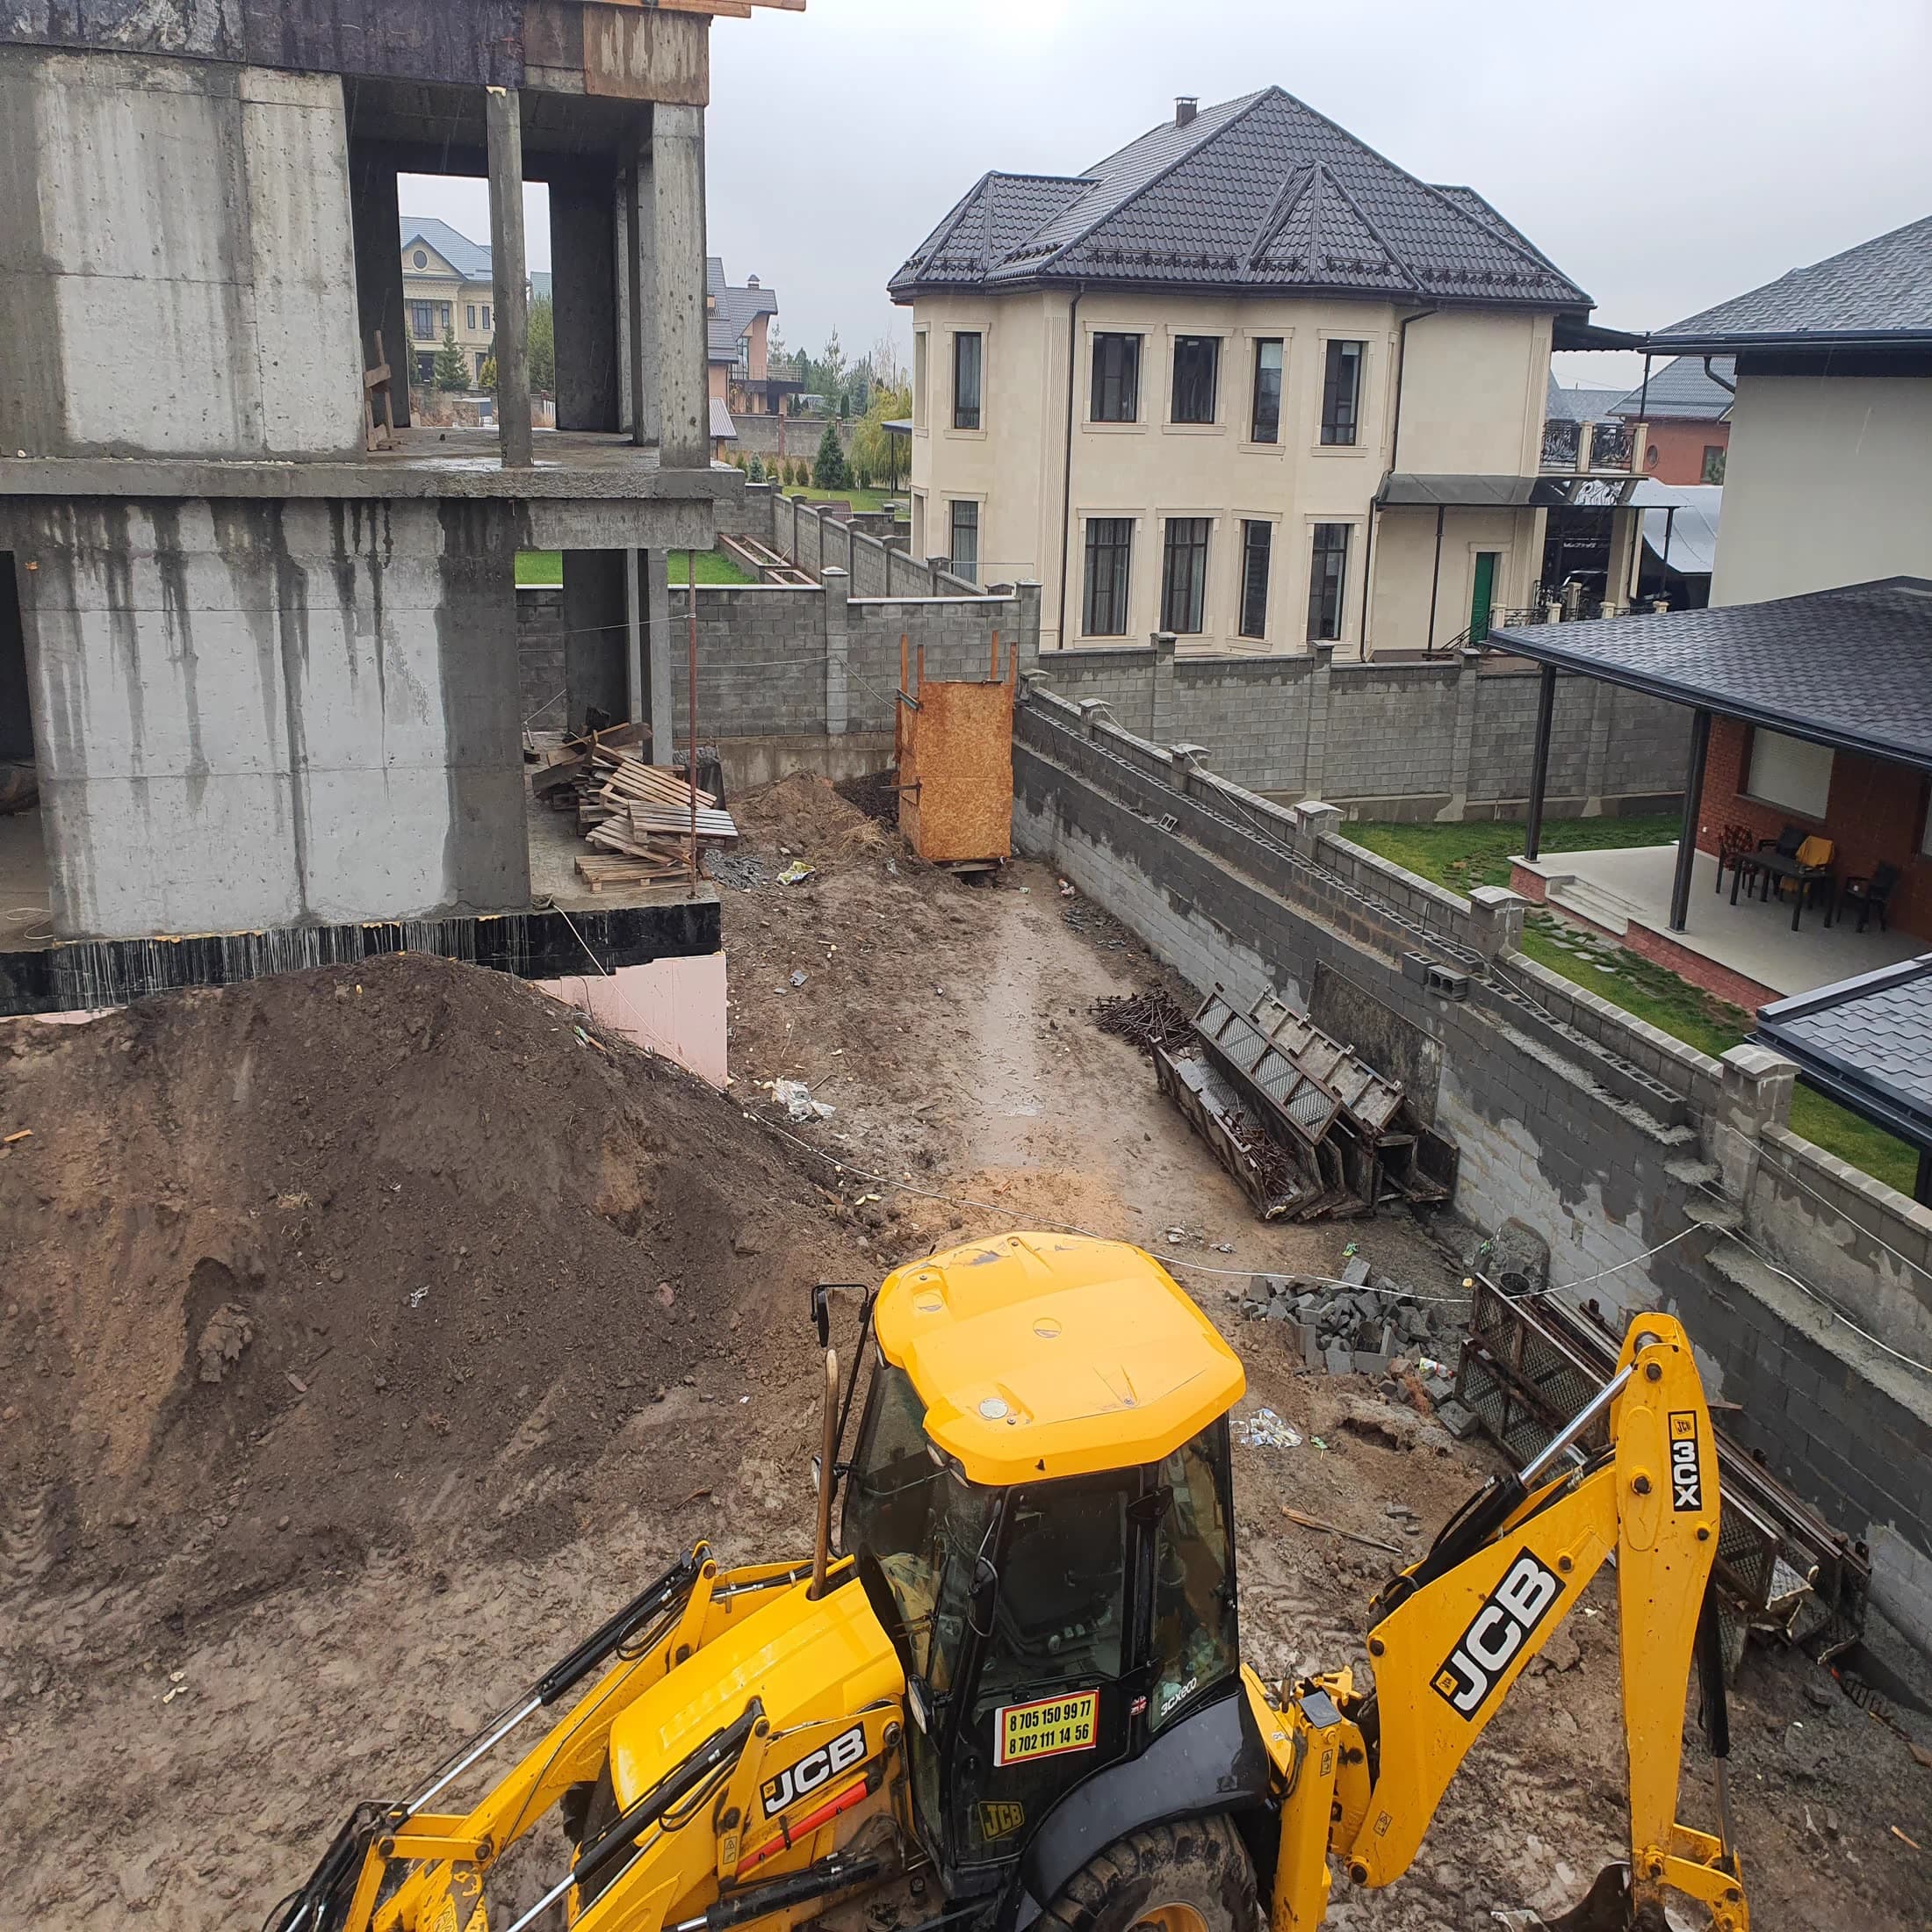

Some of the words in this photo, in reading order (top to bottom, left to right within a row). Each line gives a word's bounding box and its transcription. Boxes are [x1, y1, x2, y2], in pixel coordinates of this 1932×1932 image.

[1673, 1441, 1701, 1507] 3CX
[1451, 1558, 1556, 1712] JCB
[1009, 1738, 1016, 1754] 8
[1019, 1734, 1038, 1752] 702
[1040, 1730, 1055, 1747] 111
[1059, 1727, 1071, 1743] 14
[1075, 1723, 1089, 1741] 56
[1010, 1715, 1017, 1732] 8
[1020, 1711, 1039, 1730] 705
[1042, 1705, 1061, 1725] 150
[1063, 1702, 1078, 1720] 99
[1080, 1699, 1091, 1717] 77
[766, 1728, 865, 1813] JCB
[984, 1805, 1022, 1836] JCB
